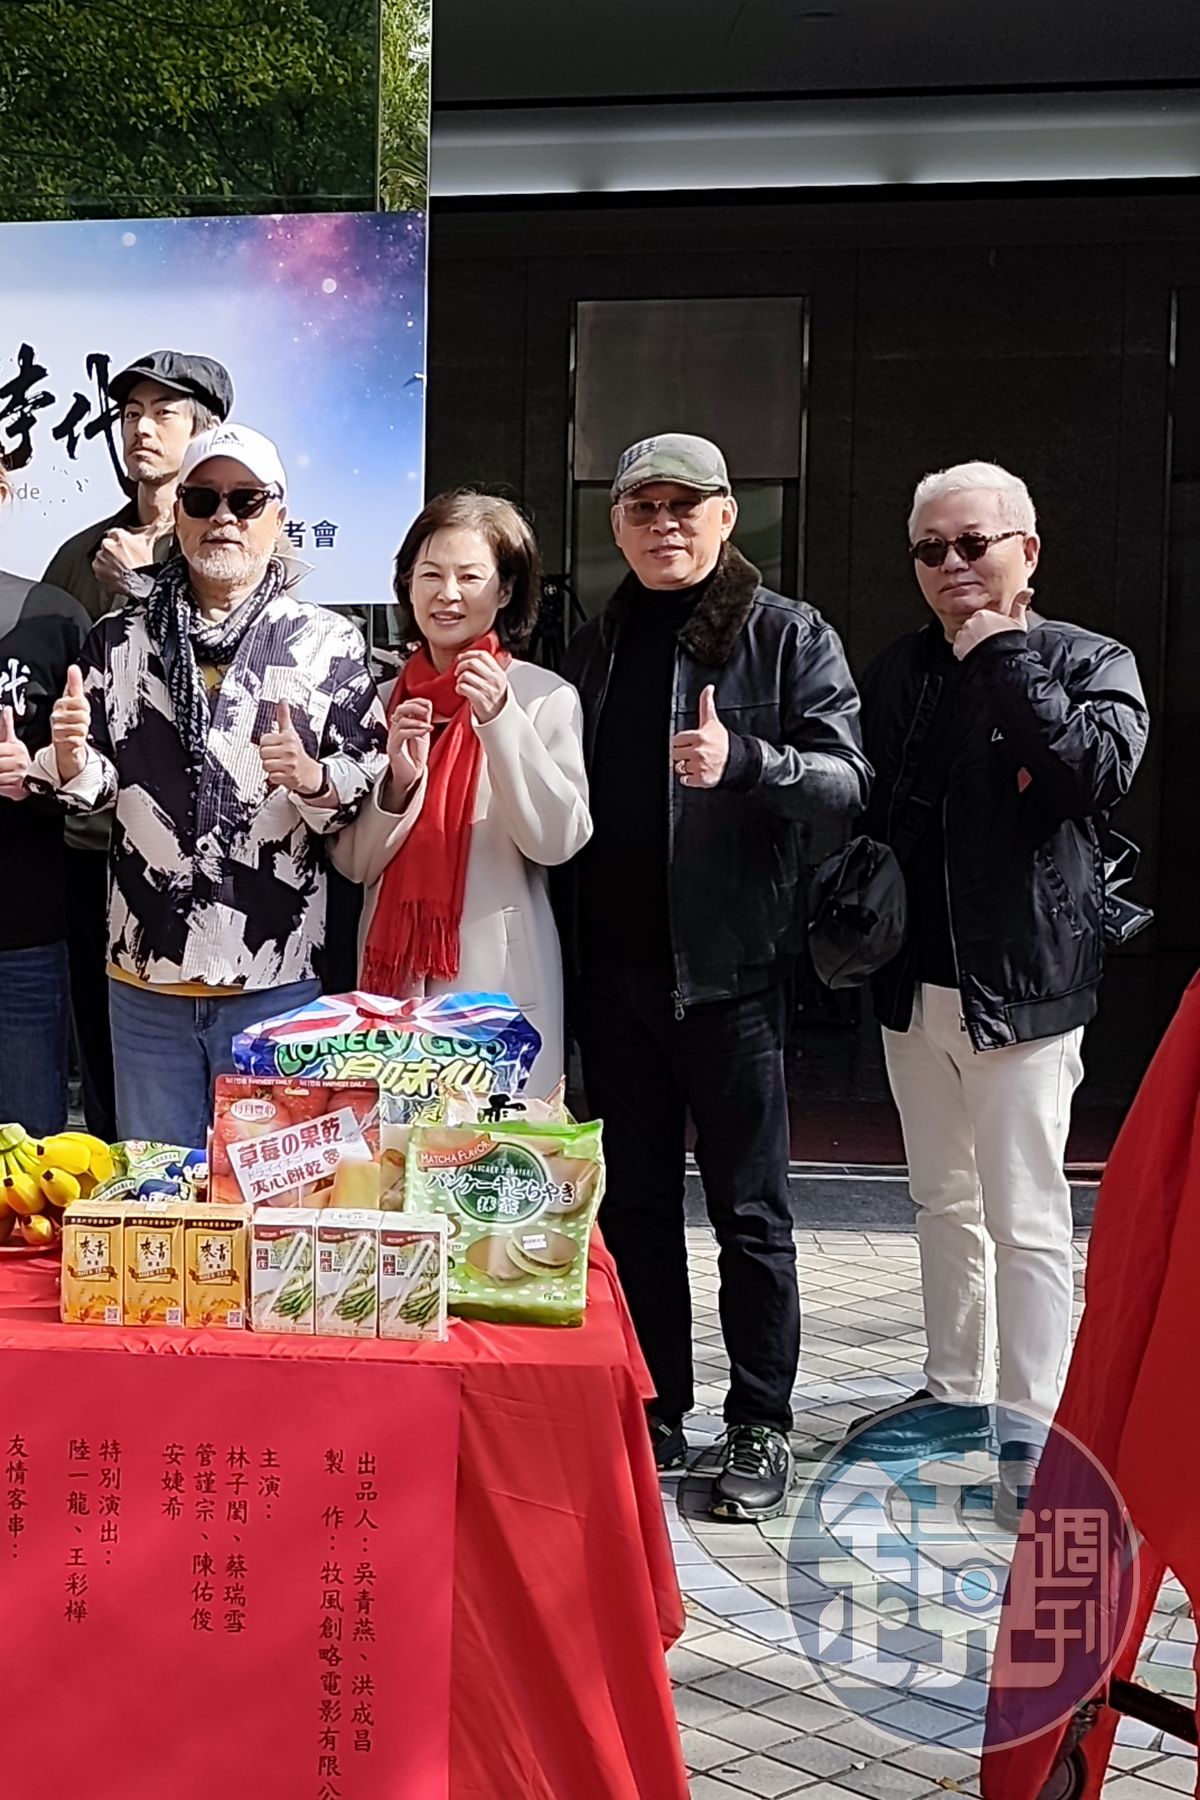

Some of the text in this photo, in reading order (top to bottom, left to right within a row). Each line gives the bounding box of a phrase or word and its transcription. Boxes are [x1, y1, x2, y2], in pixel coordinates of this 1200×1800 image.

[237, 1117, 343, 1170] 草莓の果乾
[420, 1151, 457, 1164] MATCHA
[250, 1160, 325, 1197] 夾心餅乾
